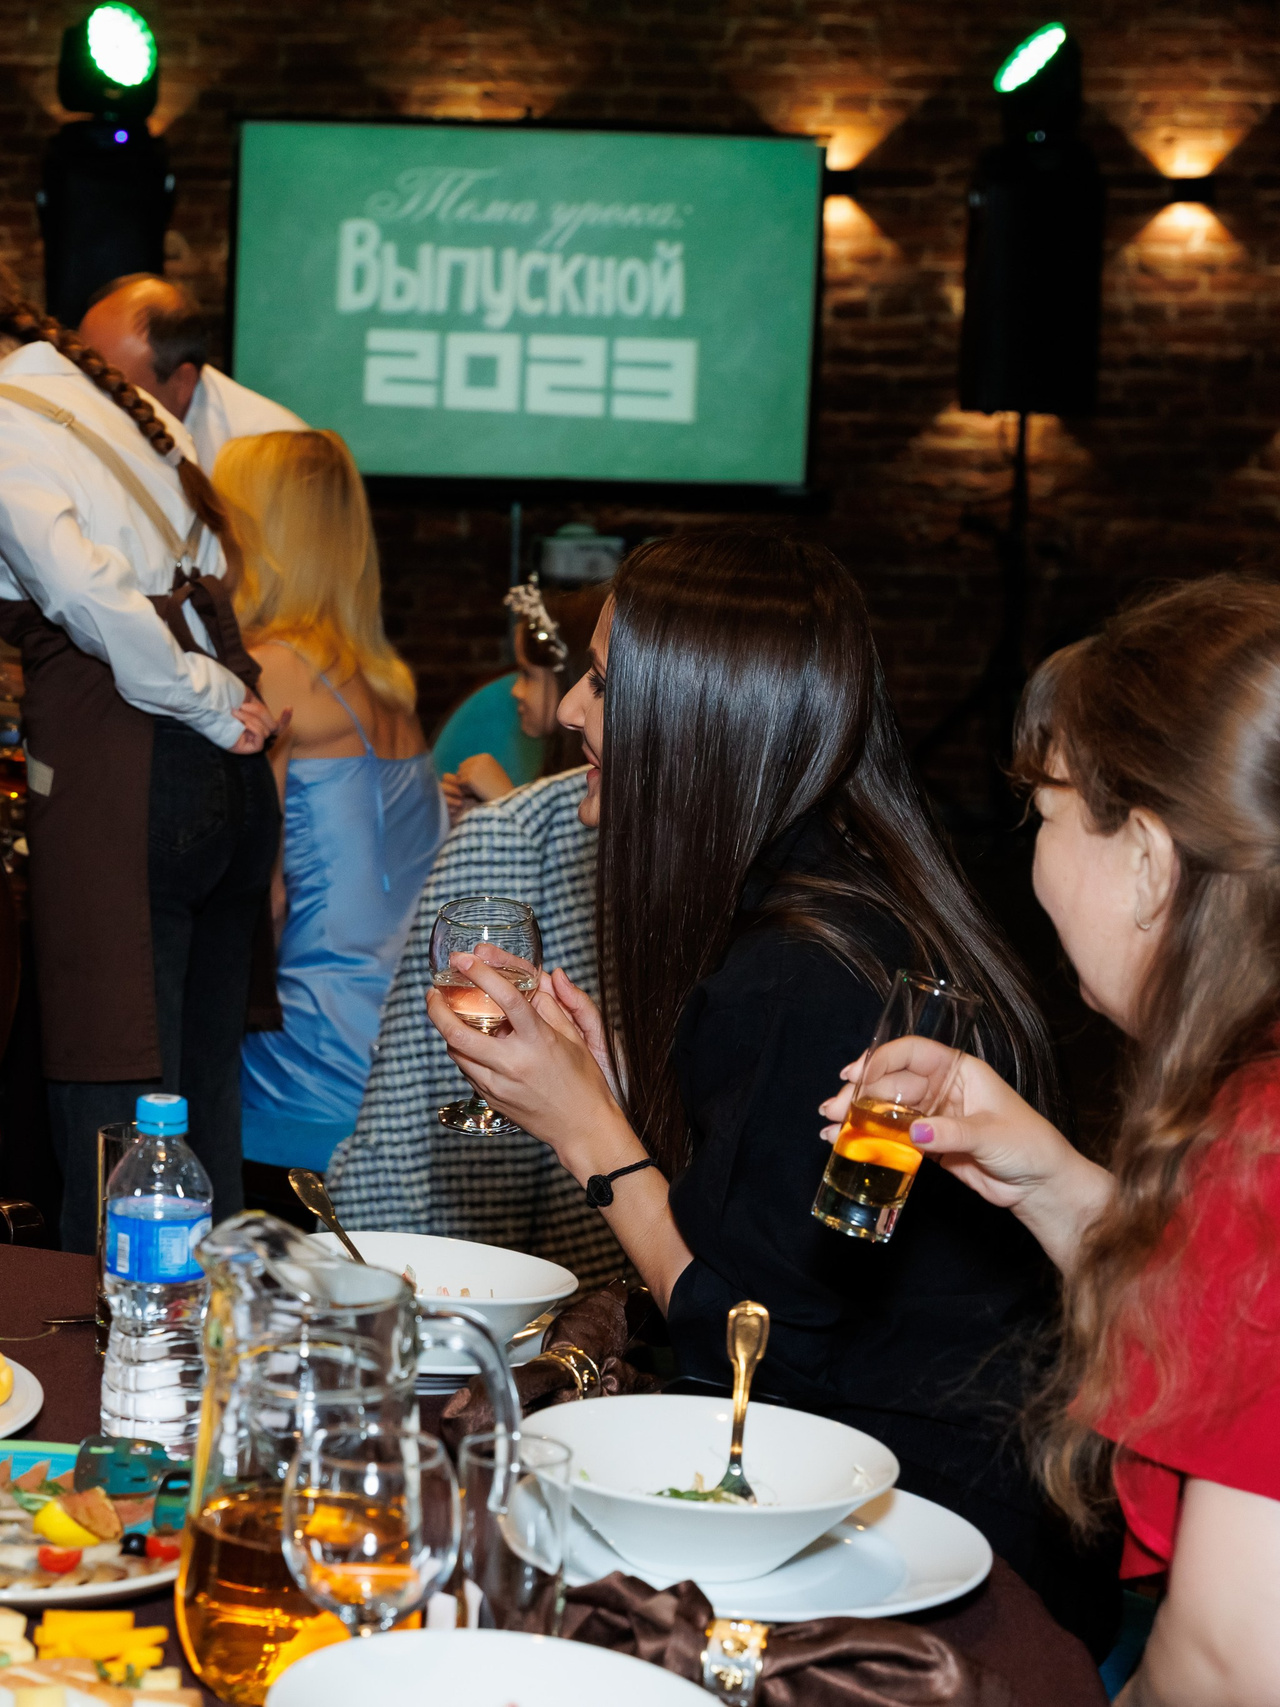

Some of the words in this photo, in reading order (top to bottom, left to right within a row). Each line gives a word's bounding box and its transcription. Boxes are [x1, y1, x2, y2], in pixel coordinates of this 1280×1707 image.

[365, 166, 539, 225] Тема
[336, 218, 685, 328] Выпускной
[363, 327, 698, 424] 2023
